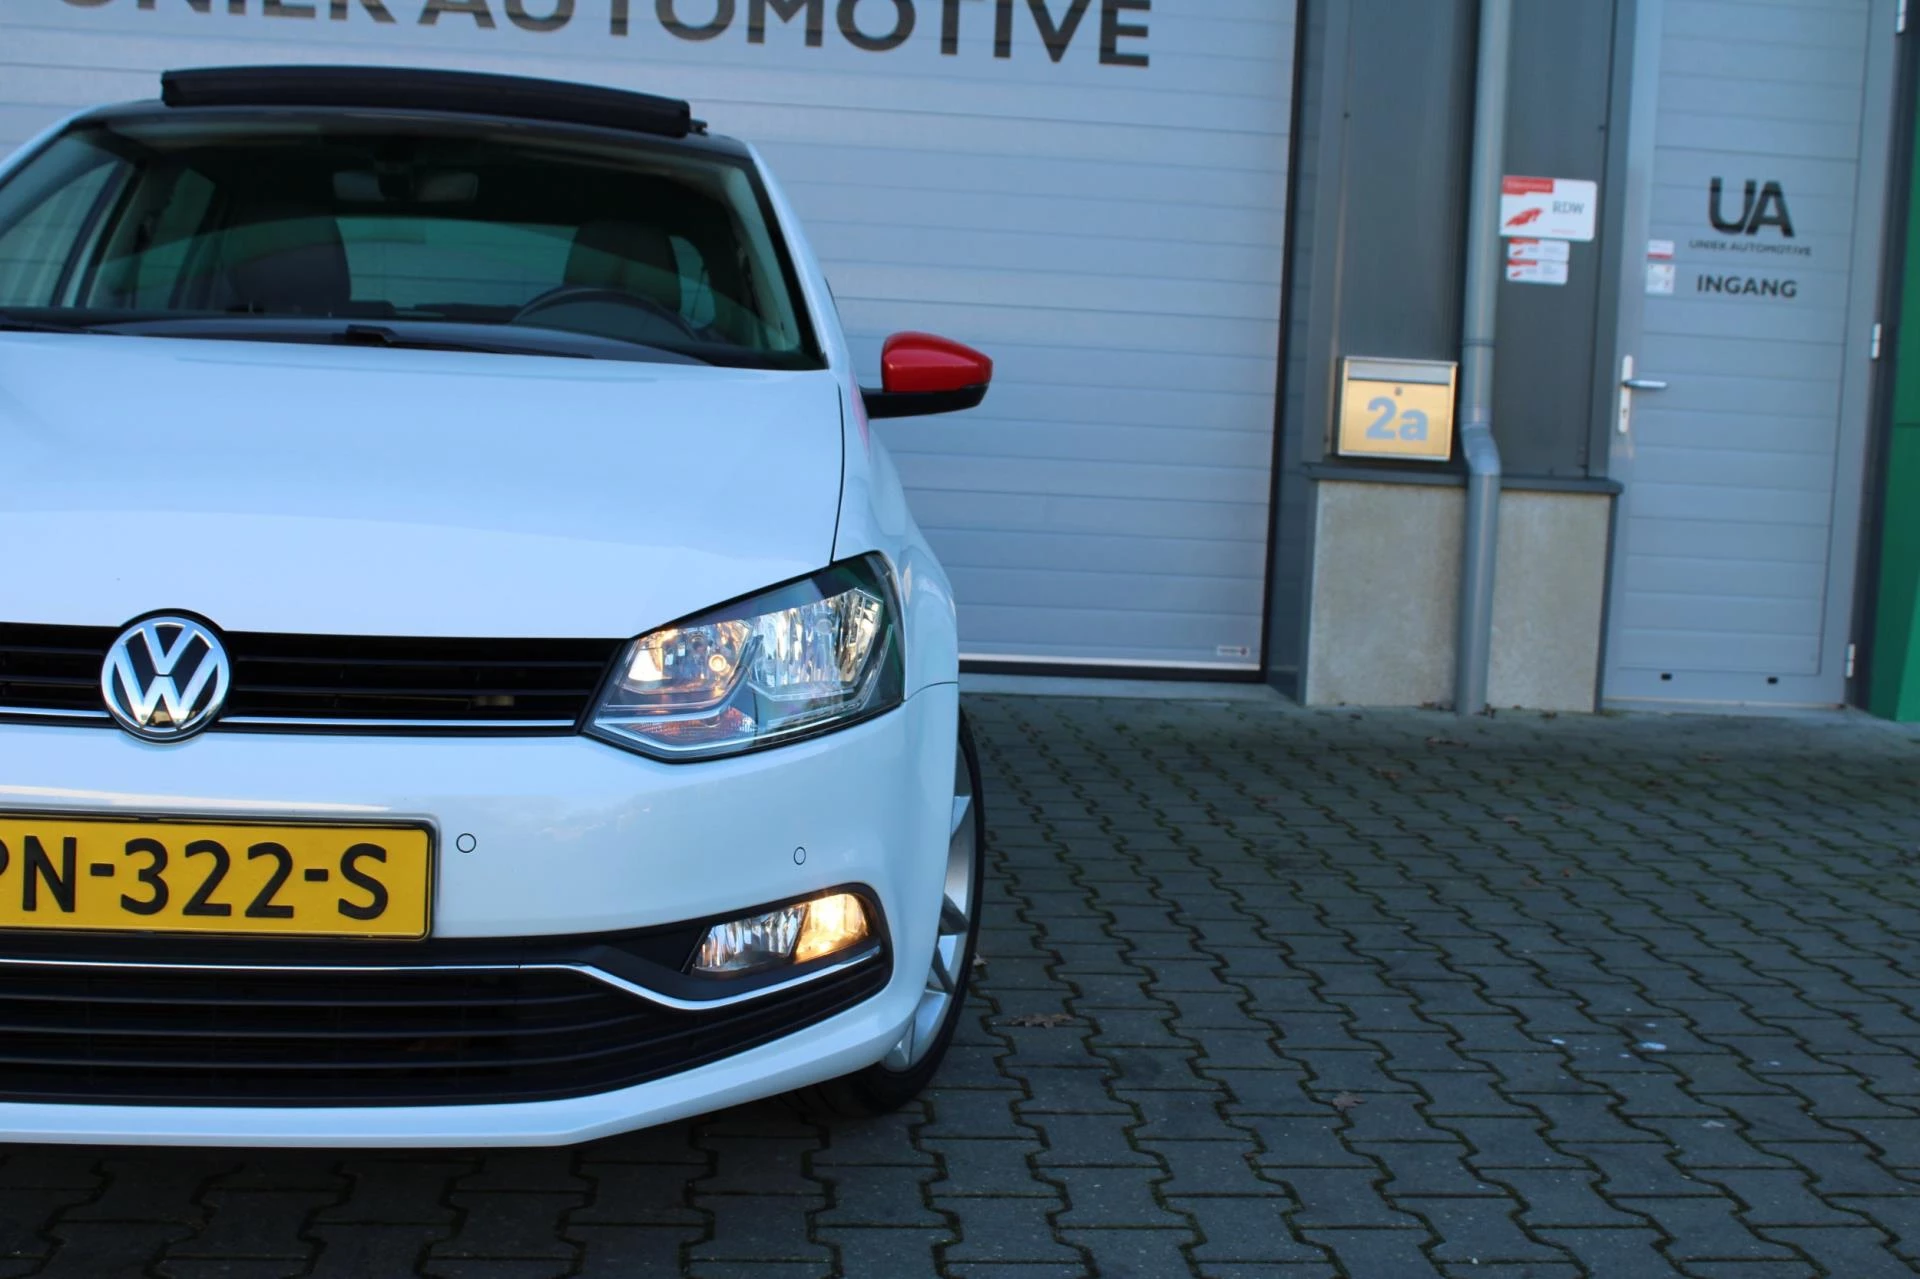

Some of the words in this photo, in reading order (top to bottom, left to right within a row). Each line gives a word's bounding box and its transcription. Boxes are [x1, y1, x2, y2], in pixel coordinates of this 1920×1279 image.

[1552, 200, 1585, 215] RDW
[1709, 177, 1795, 238] UA
[1730, 243, 1813, 257] AUTOMOTIVE
[1697, 274, 1798, 298] INGANG
[1365, 396, 1429, 441] 2a
[101, 616, 230, 734] VW
[0, 835, 389, 921] N-322-S
